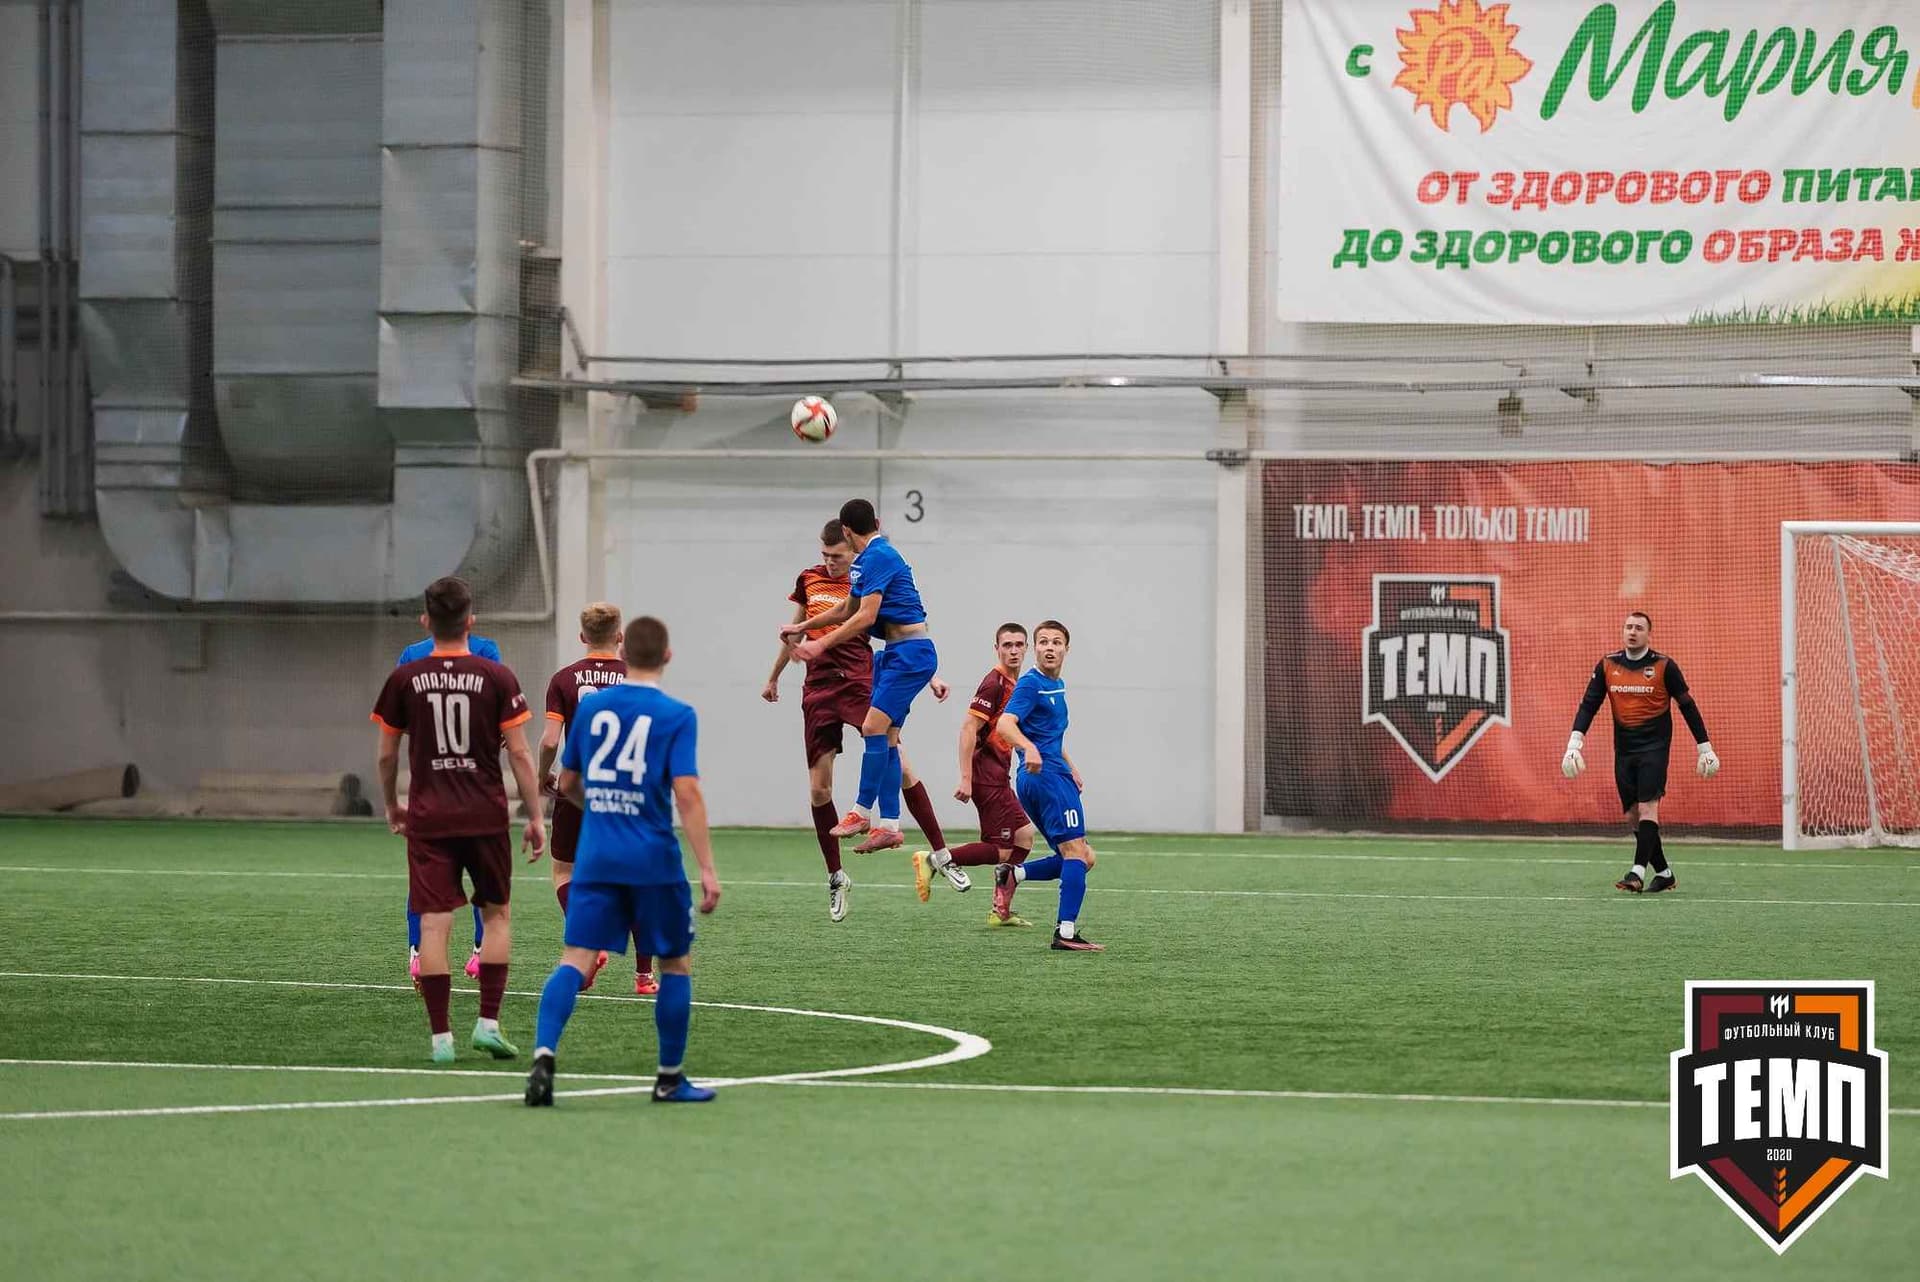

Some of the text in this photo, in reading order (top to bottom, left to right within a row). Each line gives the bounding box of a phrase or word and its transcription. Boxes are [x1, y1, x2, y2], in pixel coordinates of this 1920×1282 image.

[1540, 0, 1909, 122] Мария
[1417, 171, 1479, 204] ОТ
[1486, 169, 1772, 211] ЗДОРОВОГО
[1333, 230, 1403, 269] ДО
[1410, 228, 1693, 270] ЗДОРОВОГО
[1702, 228, 1885, 263] ОБРАЗА
[905, 490, 925, 523] 3
[1294, 504, 1590, 544] ТЕМП, ТЕМП, ТОЛЬКО ТЕМП!
[412, 672, 484, 693] АПАЛЬКИН
[1379, 633, 1498, 704] ТЕМП
[427, 693, 470, 755] 10
[587, 710, 652, 785] 24
[1064, 809, 1079, 828] 10
